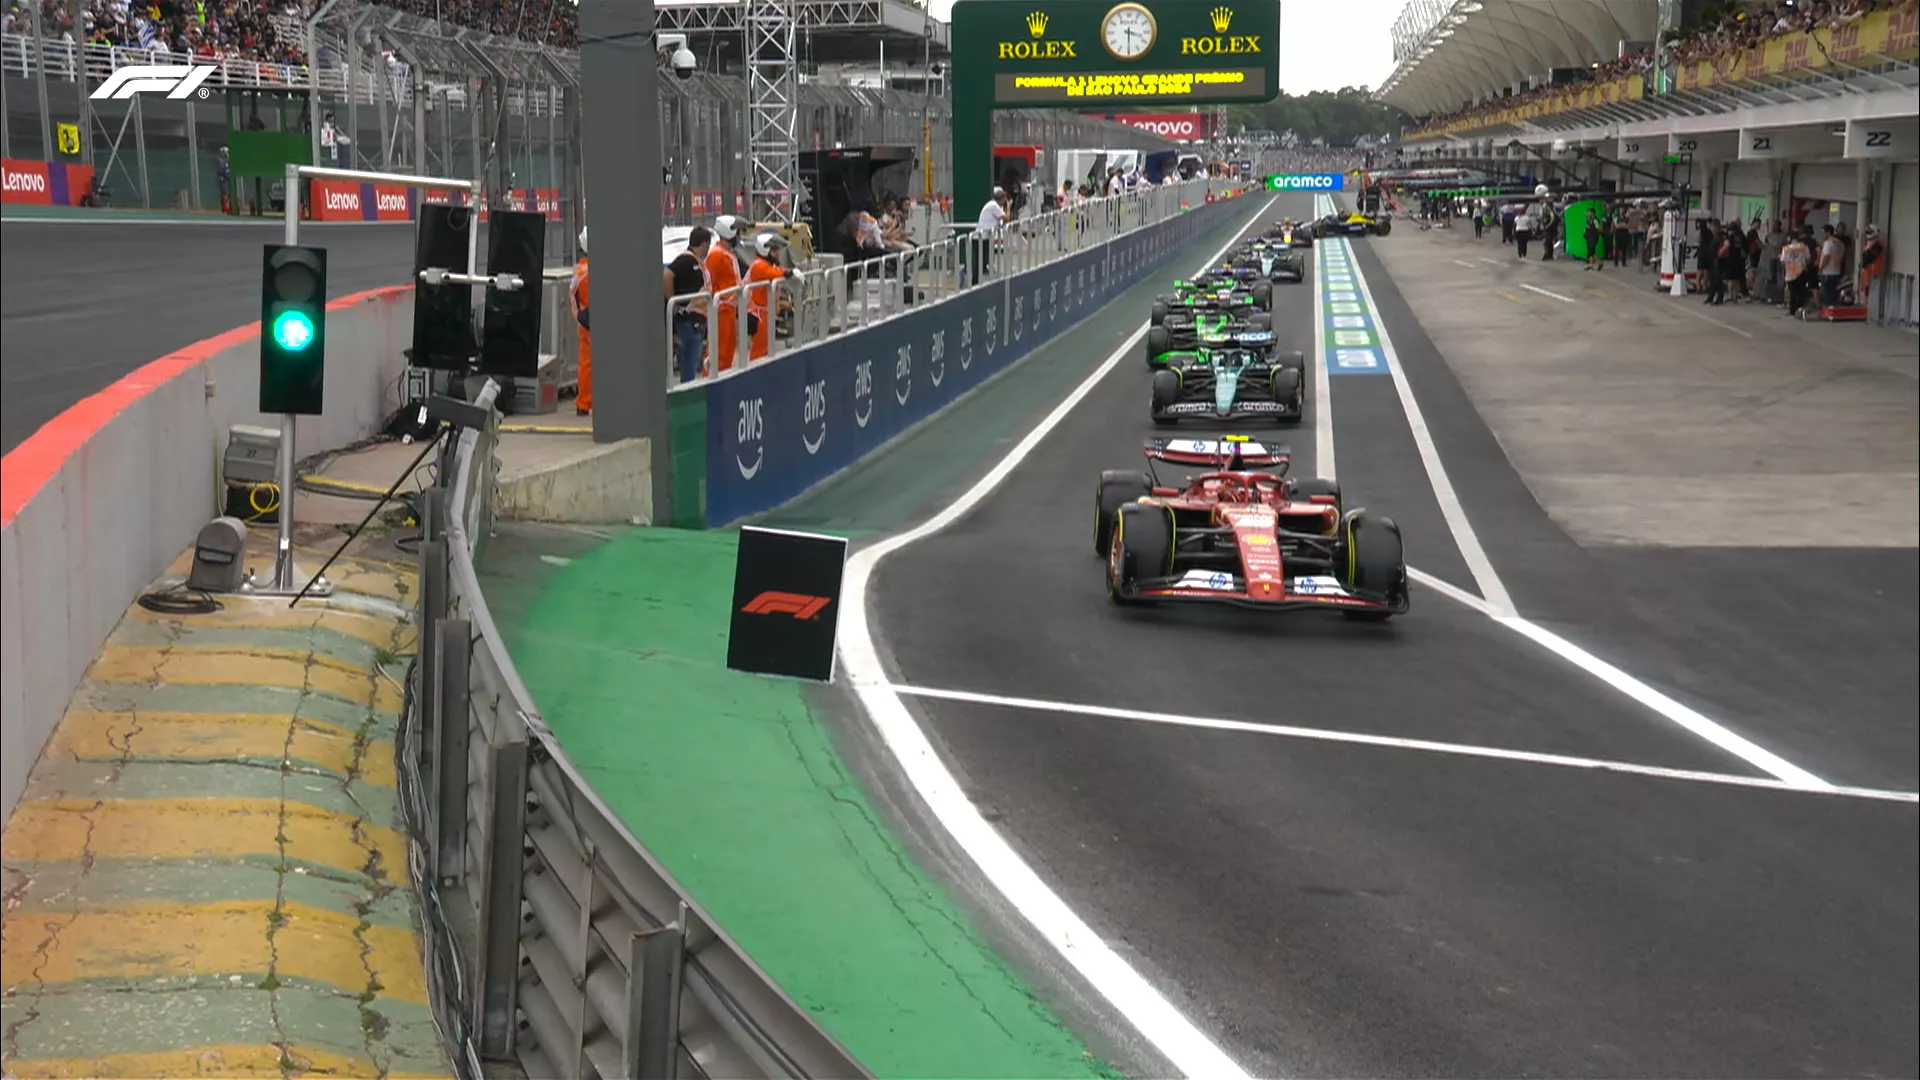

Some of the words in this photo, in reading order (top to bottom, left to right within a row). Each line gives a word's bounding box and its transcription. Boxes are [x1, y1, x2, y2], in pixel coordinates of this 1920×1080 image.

[998, 41, 1077, 59] ROLEX
[1181, 36, 1261, 55] ROLEX
[1015, 76, 1076, 87] FORMULA
[1078, 76, 1086, 86] 1
[1088, 74, 1139, 86] LENOVO
[1141, 73, 1193, 84] GRANDE
[1114, 84, 1157, 95] PAULO
[1679, 140, 1697, 150] 20
[1753, 138, 1773, 150] 21
[1865, 131, 1892, 146] 22
[1626, 144, 1639, 152] 19
[2, 168, 45, 191] Lenovo
[1274, 176, 1333, 187] aramco
[325, 190, 359, 210] Lenovo
[375, 191, 406, 210] Lenovo
[931, 329, 945, 362] aws
[896, 343, 911, 380] aws
[855, 359, 872, 399] aws
[804, 379, 825, 424] aws
[1243, 401, 1284, 412] aramco
[738, 398, 763, 443] aws
[247, 449, 257, 458] 27
